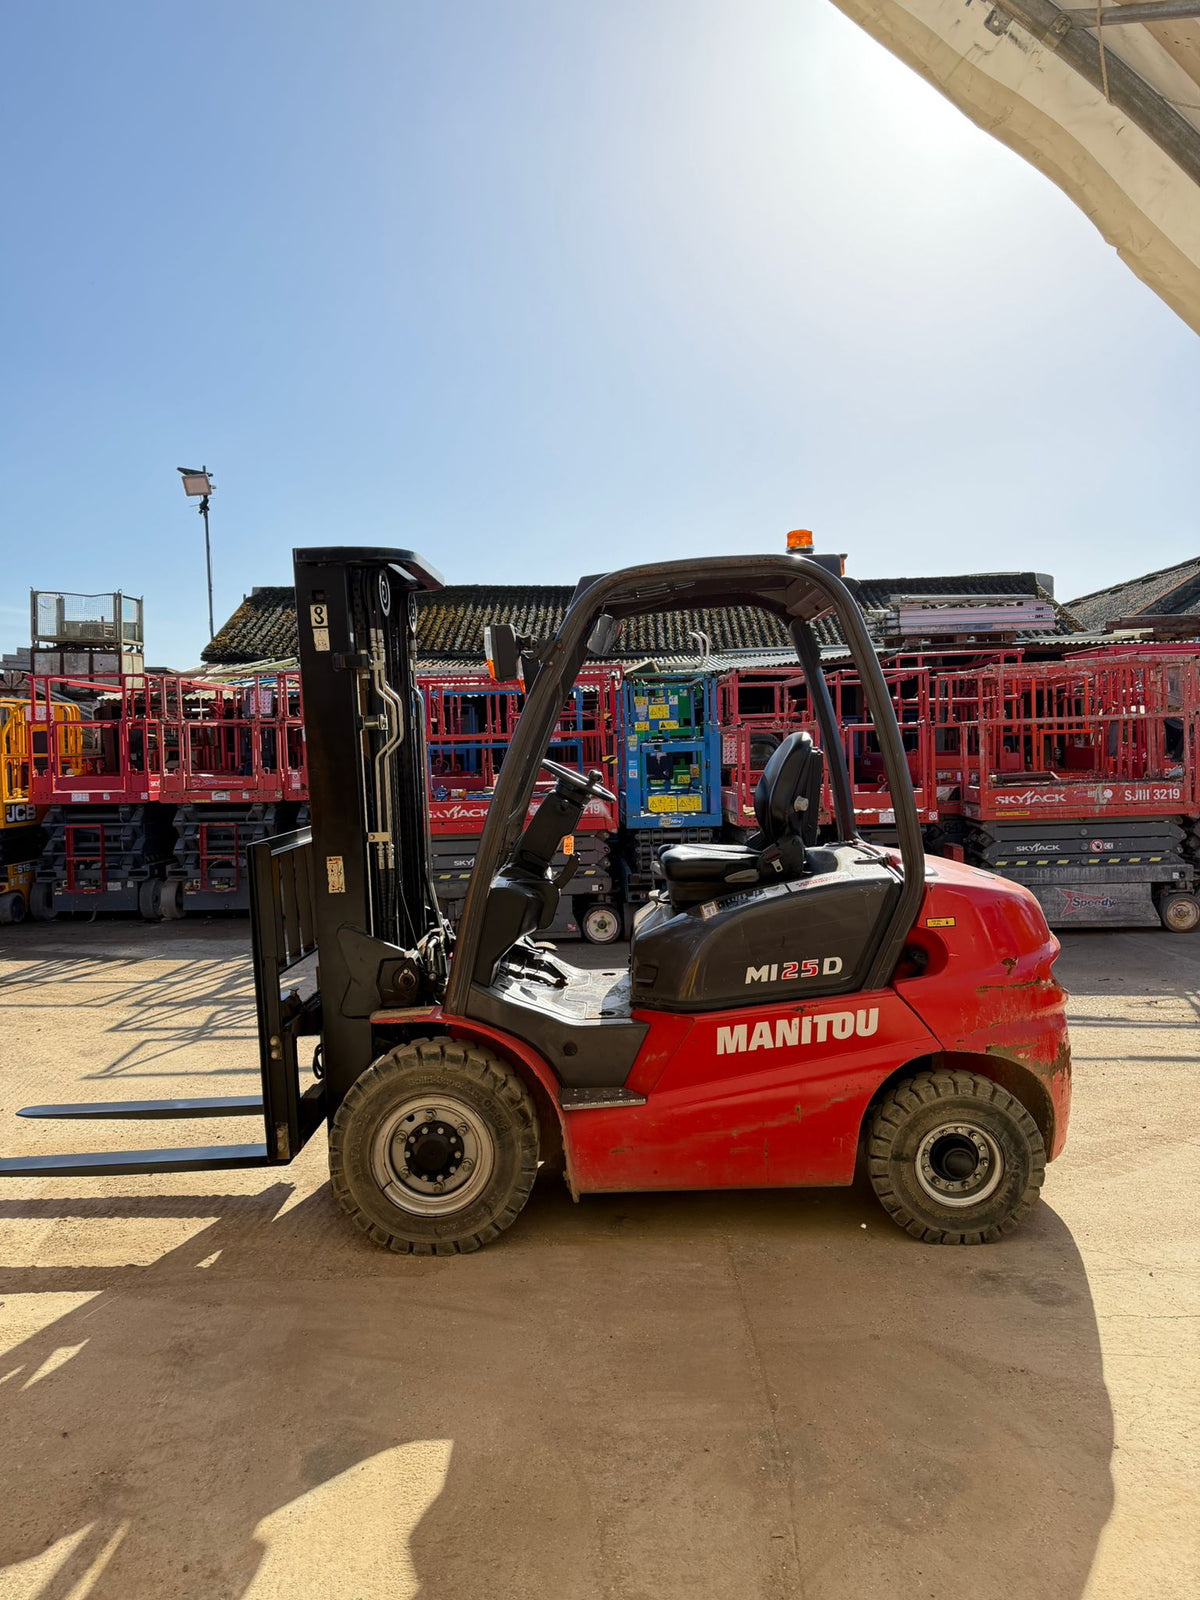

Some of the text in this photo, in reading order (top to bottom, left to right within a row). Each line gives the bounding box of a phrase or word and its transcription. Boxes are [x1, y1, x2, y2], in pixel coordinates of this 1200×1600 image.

[995, 790, 1067, 805] SKYJACK
[1153, 788, 1180, 800] 3219
[6, 804, 36, 822] JCB
[1016, 842, 1060, 852] SKYJACK
[1072, 896, 1116, 909] Speedy
[716, 1007, 879, 1056] MANITOU
